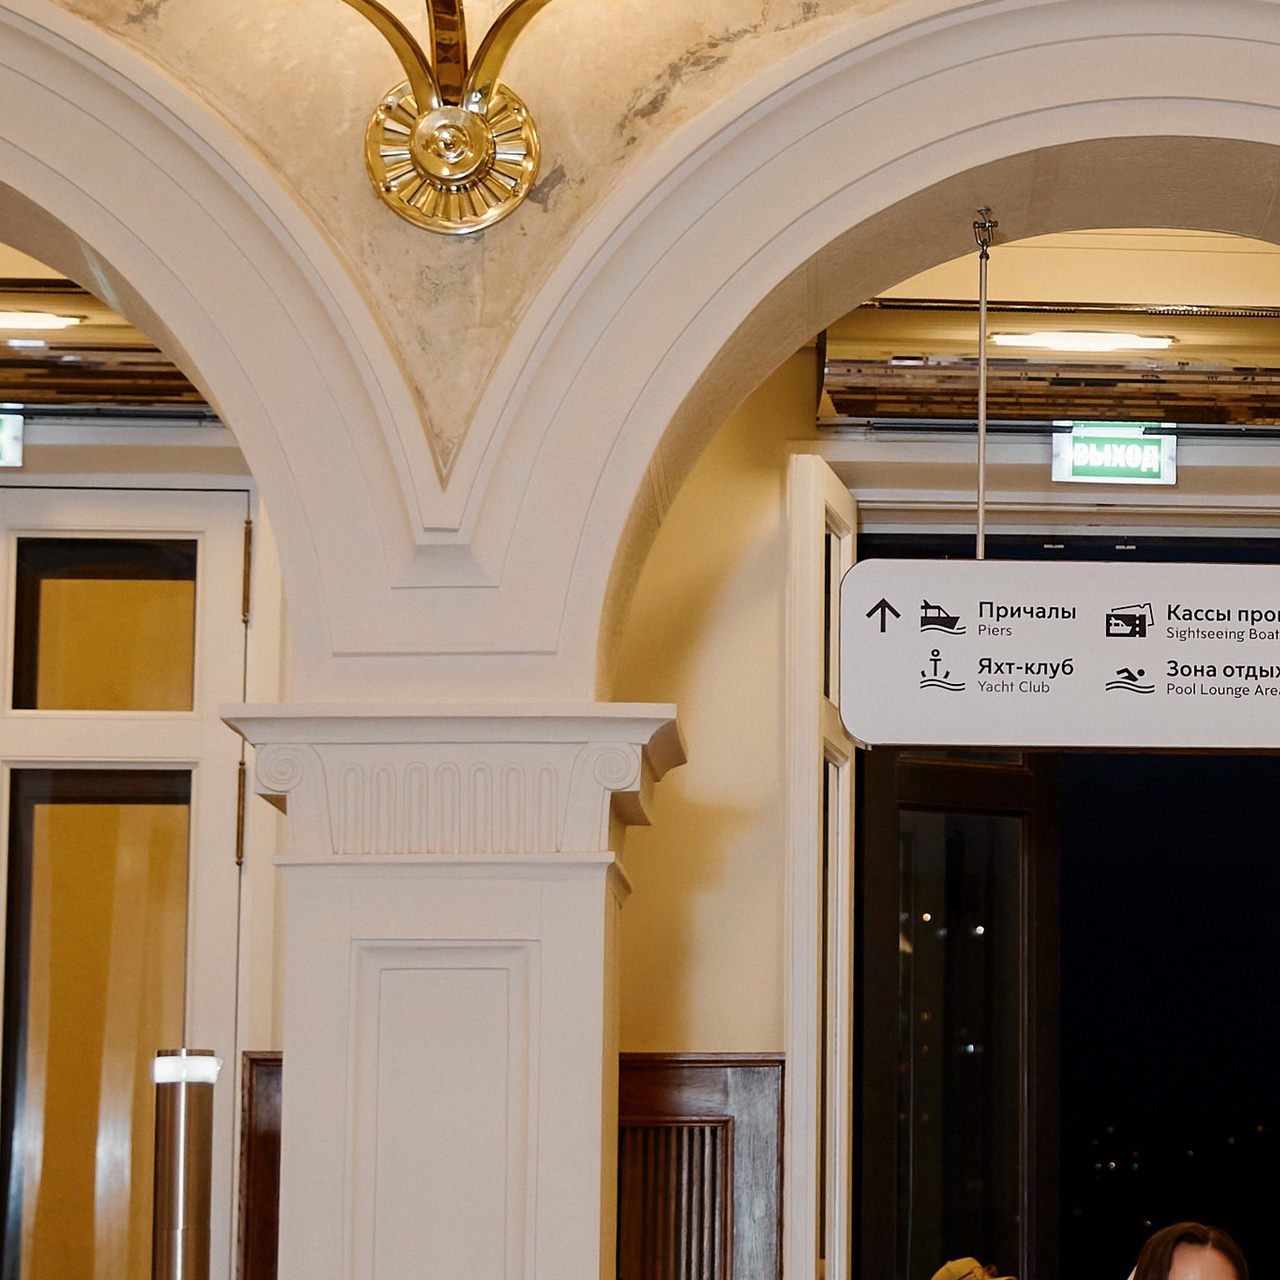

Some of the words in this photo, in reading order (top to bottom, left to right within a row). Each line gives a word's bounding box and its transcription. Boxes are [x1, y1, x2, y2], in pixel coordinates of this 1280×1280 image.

[1073, 443, 1160, 473] ВЫХОД
[979, 601, 1076, 622] Причалы
[1168, 604, 1230, 621] Кассы
[979, 625, 1012, 636] Piers
[1167, 627, 1245, 642] Sightseeing
[1249, 628, 1279, 640] Boat
[978, 658, 1073, 679] Яхт-клуб
[1167, 660, 1216, 677] Зона
[978, 681, 1014, 692] Yacht
[1019, 681, 1050, 693] Club
[1167, 683, 1195, 695] Pool
[1201, 684, 1250, 698] Lounge
